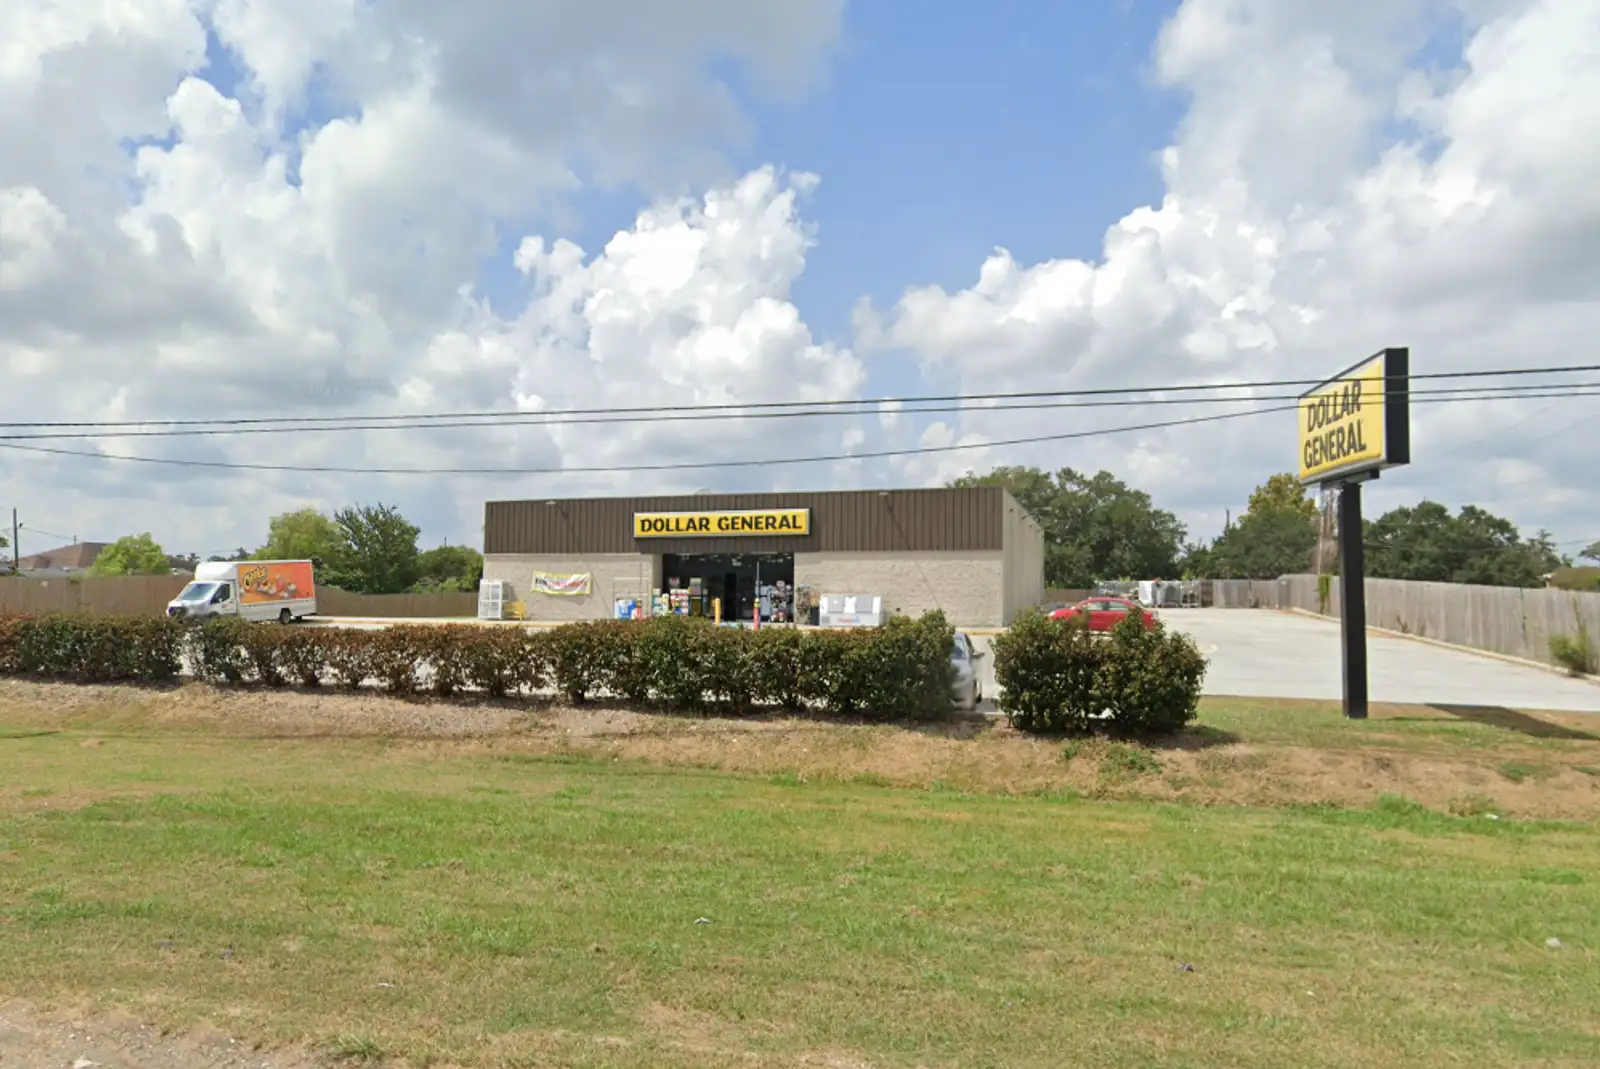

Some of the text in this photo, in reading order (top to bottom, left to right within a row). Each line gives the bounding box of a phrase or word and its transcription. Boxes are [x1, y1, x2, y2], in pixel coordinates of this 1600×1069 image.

[1308, 380, 1362, 432] DOLLAR
[1304, 420, 1367, 469] GENERAL
[640, 515, 802, 532] DOLLAR GENERAL
